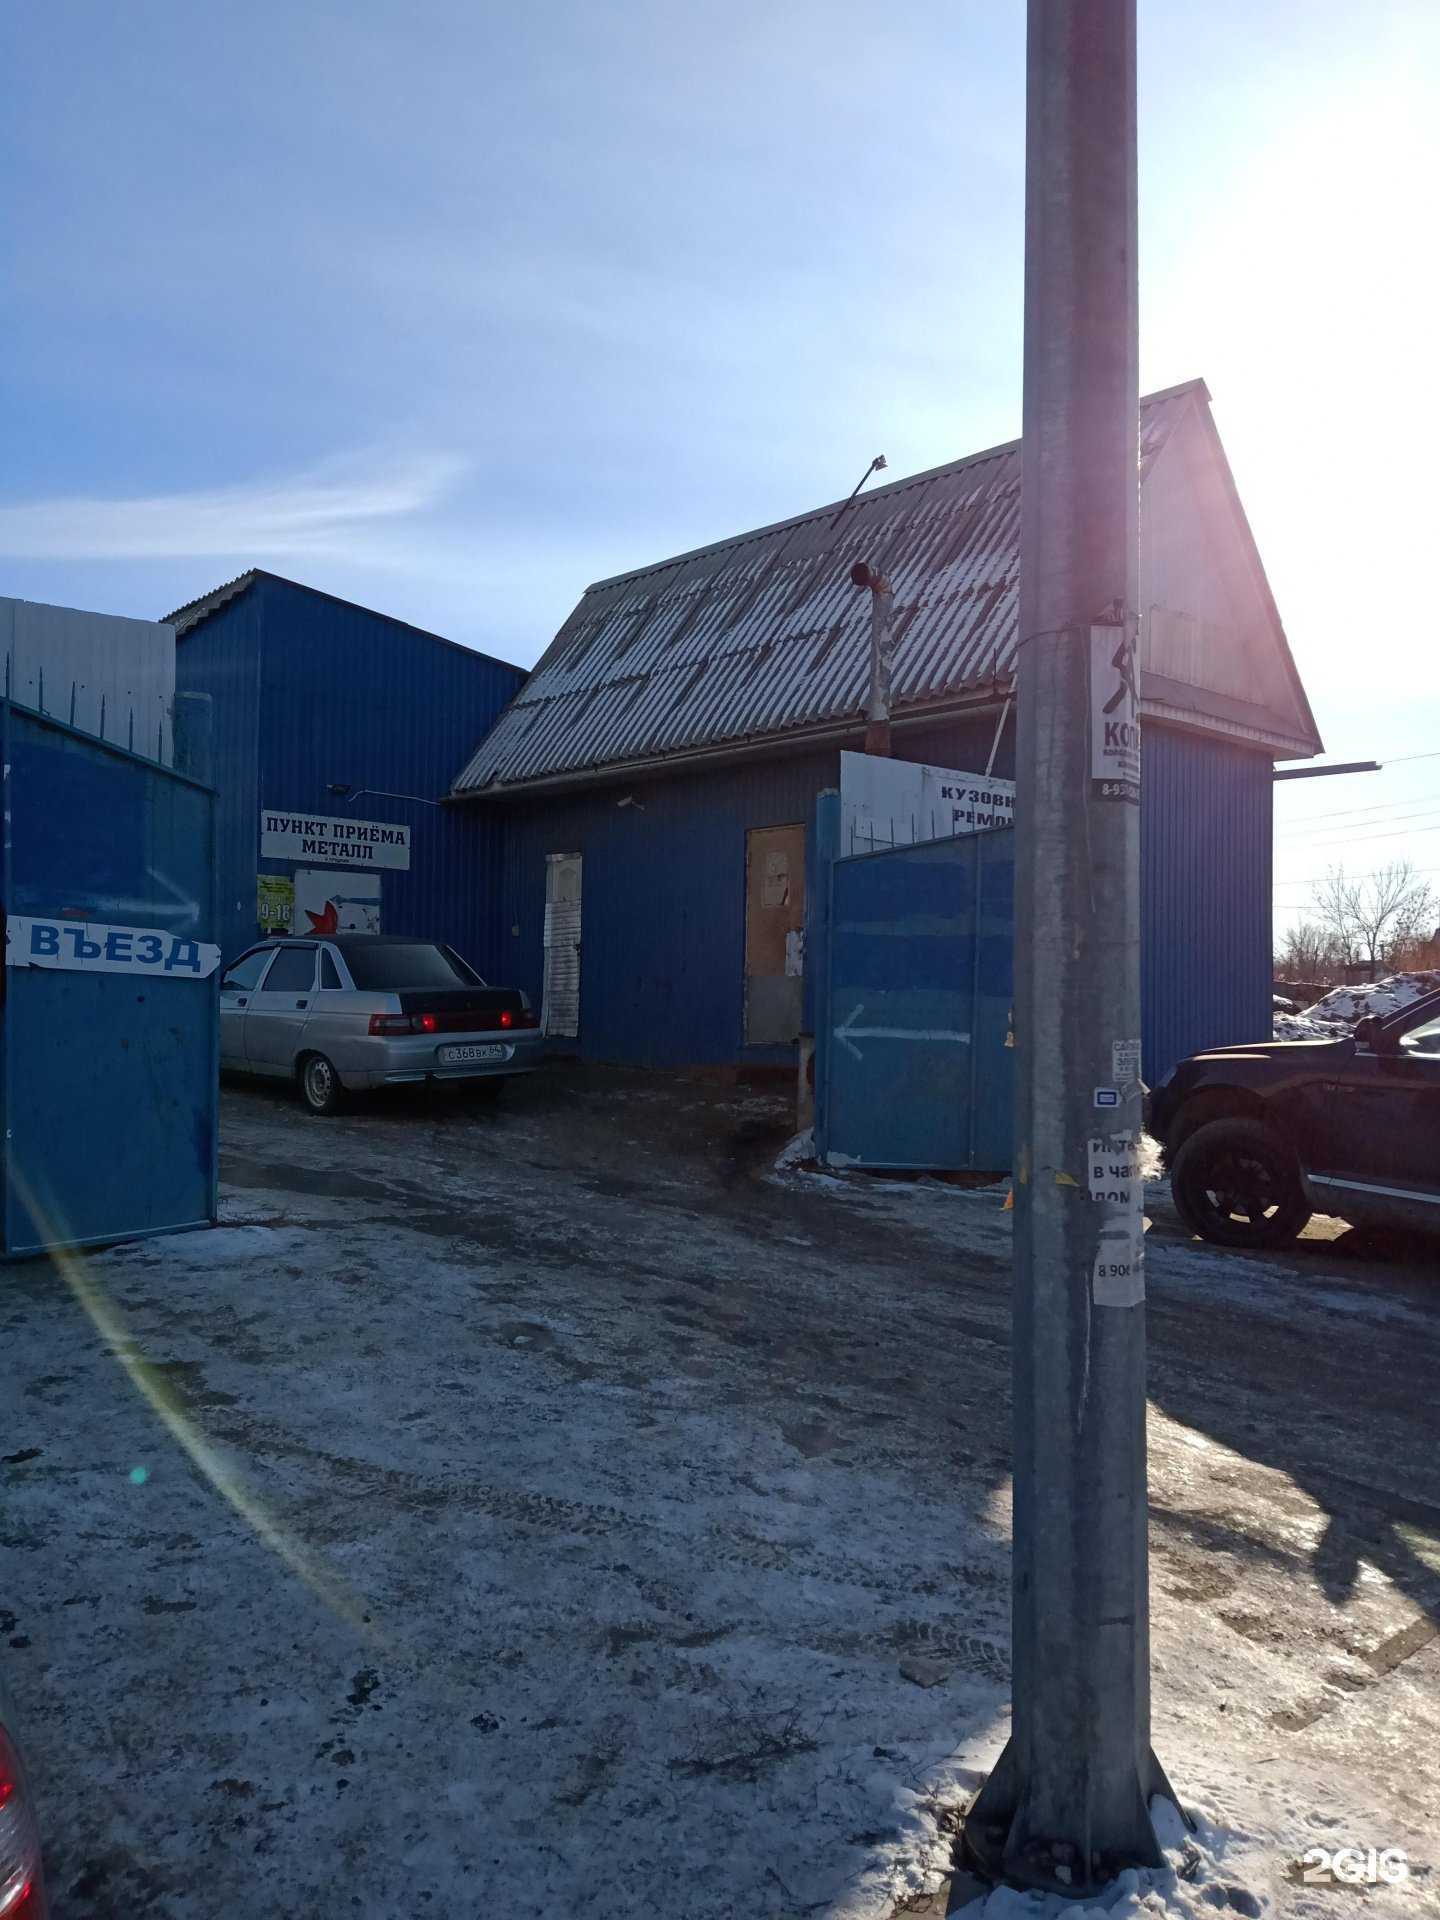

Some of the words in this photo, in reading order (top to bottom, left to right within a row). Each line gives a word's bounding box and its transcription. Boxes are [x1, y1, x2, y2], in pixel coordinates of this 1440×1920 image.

[266, 817, 328, 837] ПУНКТ
[333, 823, 406, 846] ПРИЁМА
[302, 839, 374, 860] МЕТАЛЛ
[261, 903, 290, 921] 9-18
[30, 924, 201, 973] ВЪЕЗД
